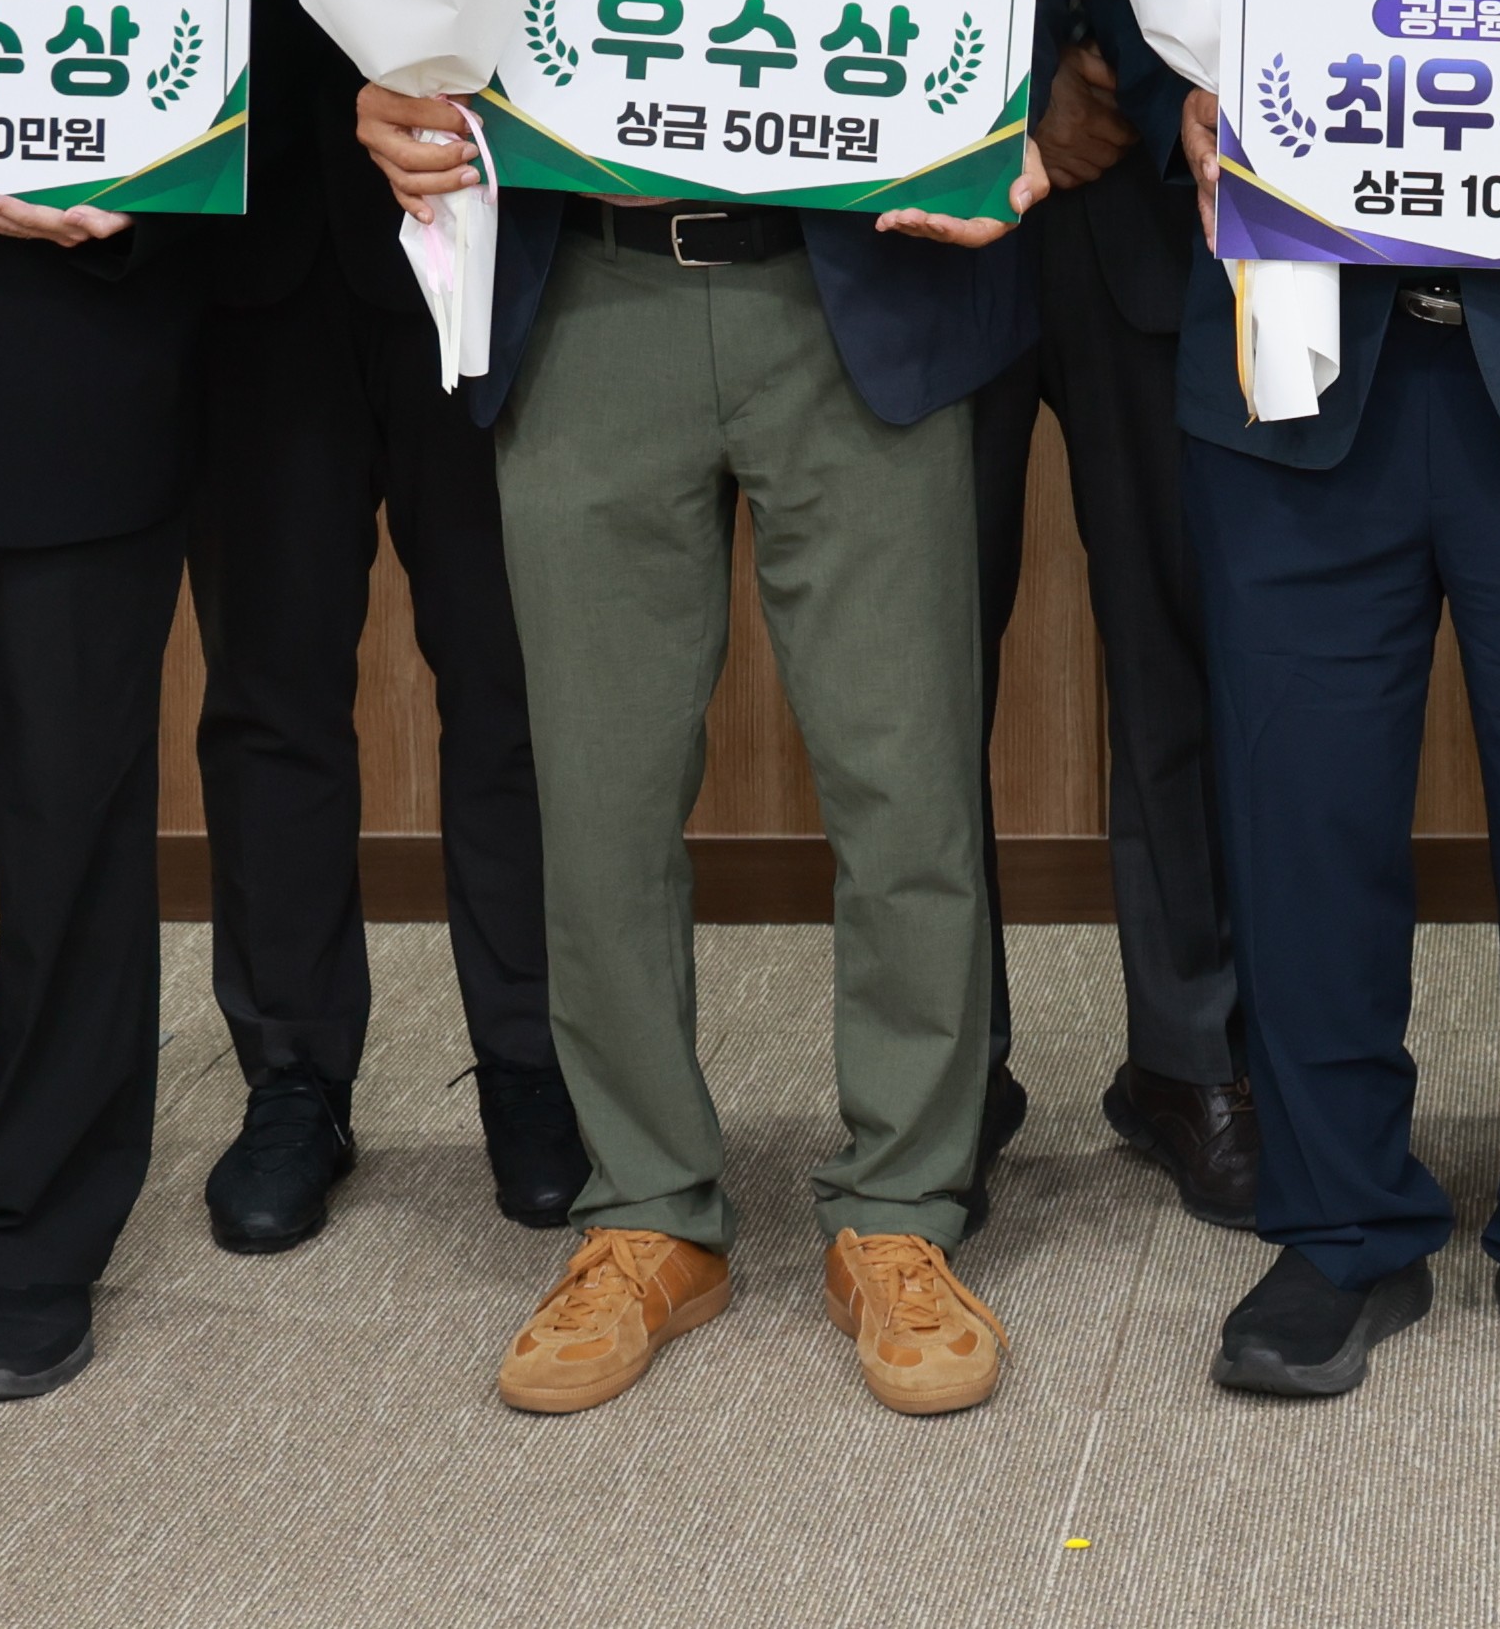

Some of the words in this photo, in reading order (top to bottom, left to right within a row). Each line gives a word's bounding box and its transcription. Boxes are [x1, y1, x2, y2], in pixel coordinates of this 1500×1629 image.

[617, 102, 707, 150] 상금
[723, 110, 879, 163] 50만원
[1354, 170, 1444, 216] 상금
